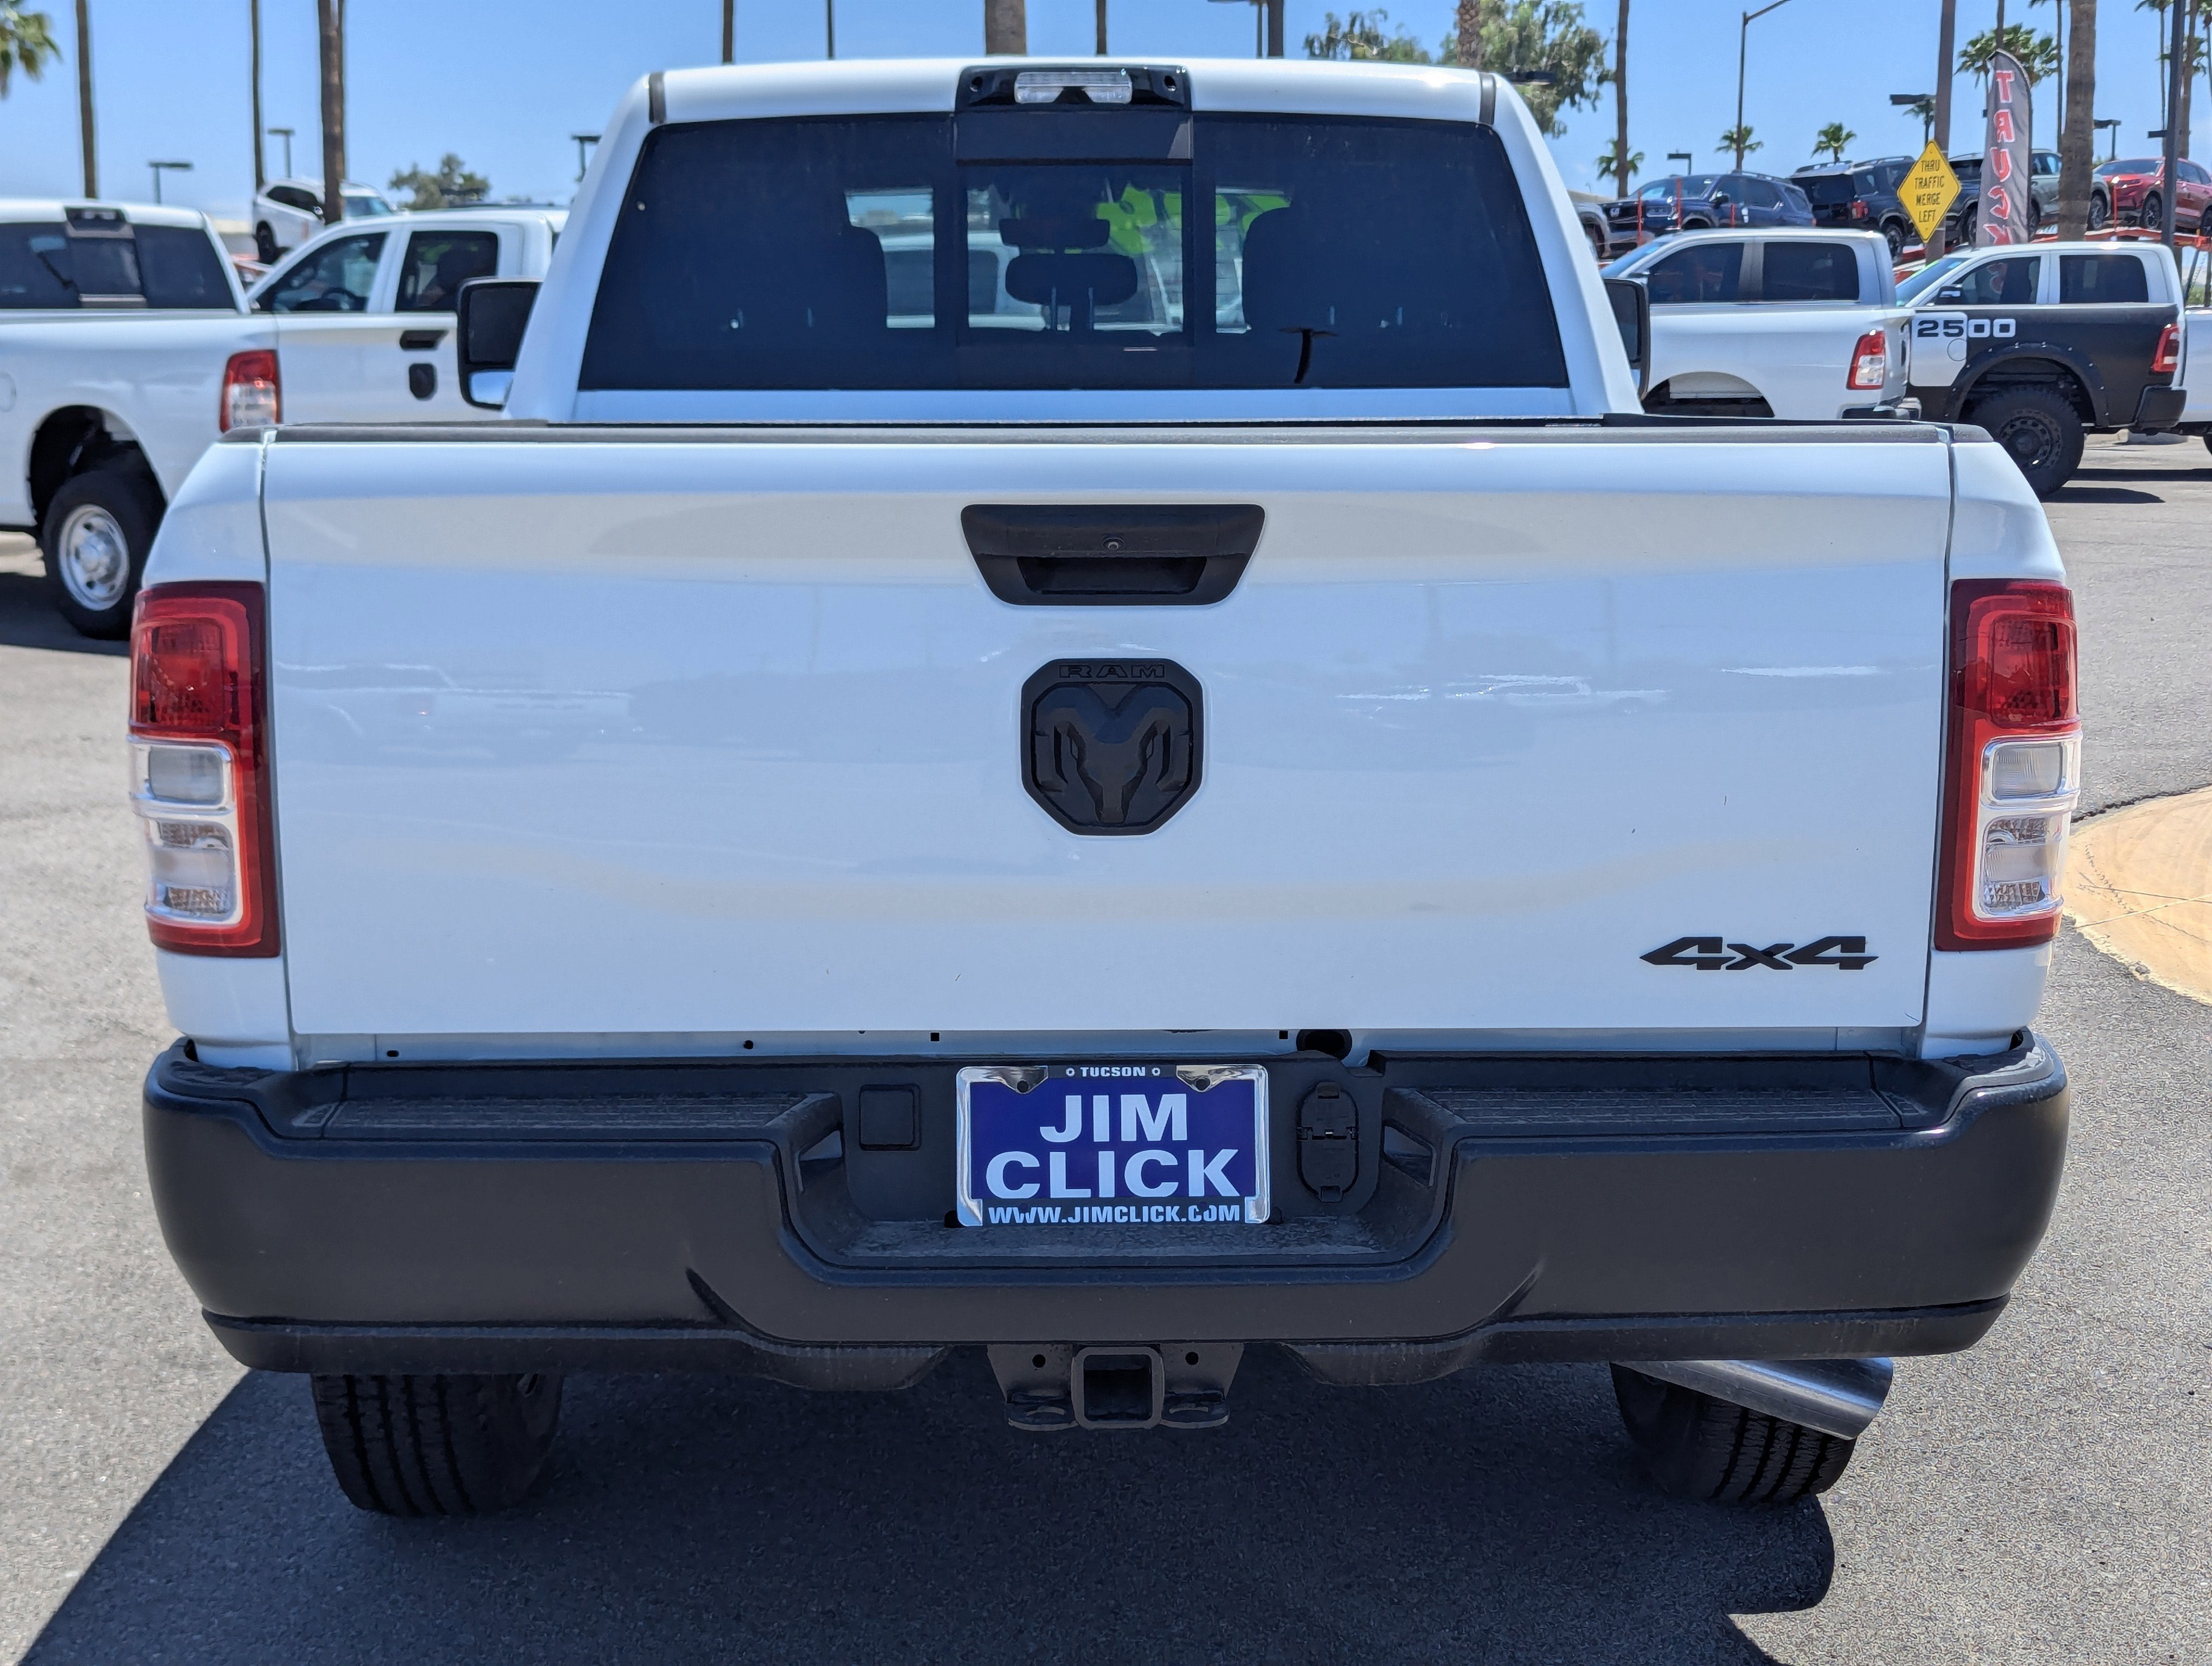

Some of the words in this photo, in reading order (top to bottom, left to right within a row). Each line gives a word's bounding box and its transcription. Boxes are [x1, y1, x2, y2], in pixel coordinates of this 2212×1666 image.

[1921, 159, 1940, 172] THRU
[1915, 176, 1945, 189] TRAFFIC
[1915, 193, 1941, 206] MERGE
[1919, 210, 1936, 223] LEFT
[1917, 319, 2016, 338] 2500
[1059, 664, 1165, 678] RAM
[1639, 936, 1879, 970] 4x4
[1080, 1066, 1146, 1077] TUCSON
[1039, 1093, 1187, 1143] JIM
[986, 1149, 1240, 1199] CLICK
[988, 1204, 1240, 1224] WWW.JIMCLICK.COM
